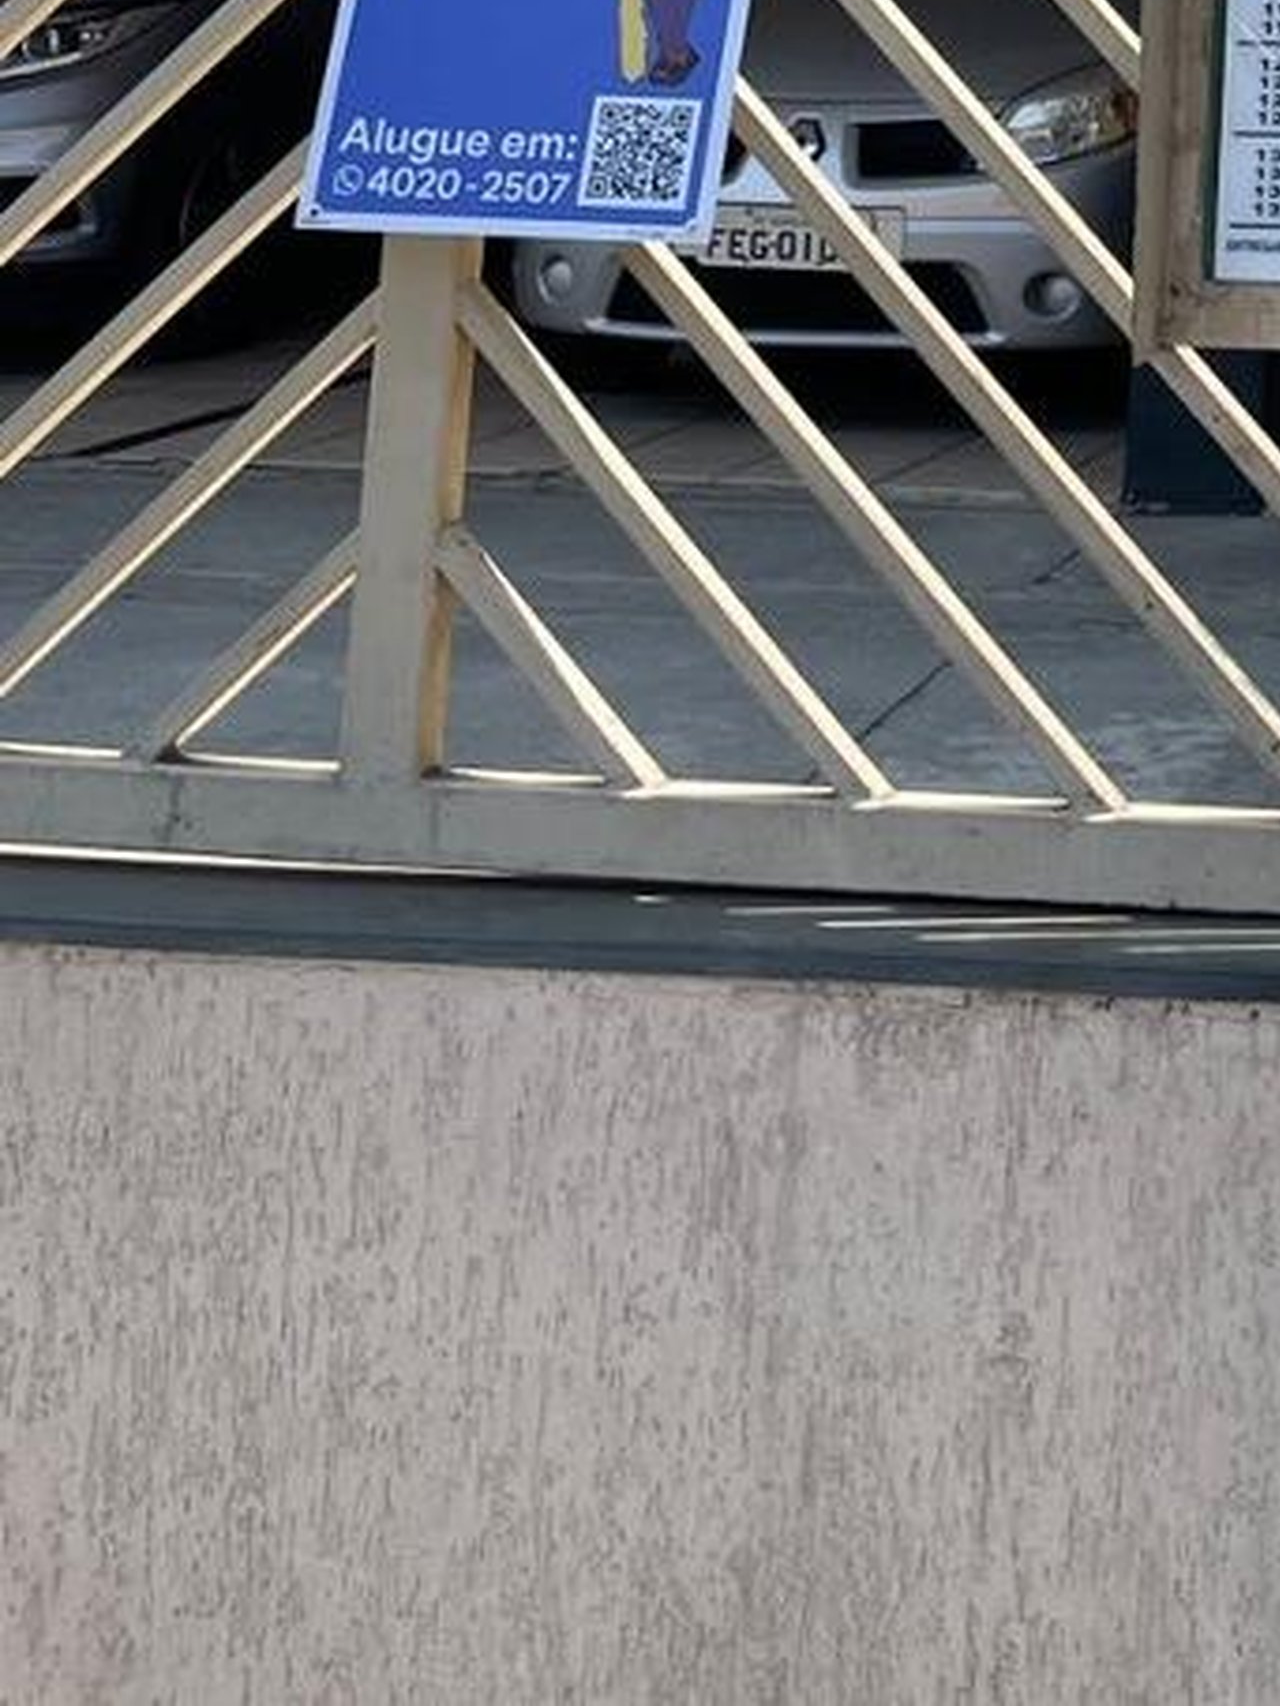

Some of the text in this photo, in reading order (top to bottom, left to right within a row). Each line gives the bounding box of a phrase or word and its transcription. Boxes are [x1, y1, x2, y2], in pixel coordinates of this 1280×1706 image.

[338, 117, 578, 163] Alugue em:
[367, 165, 572, 204] 4020-2507
